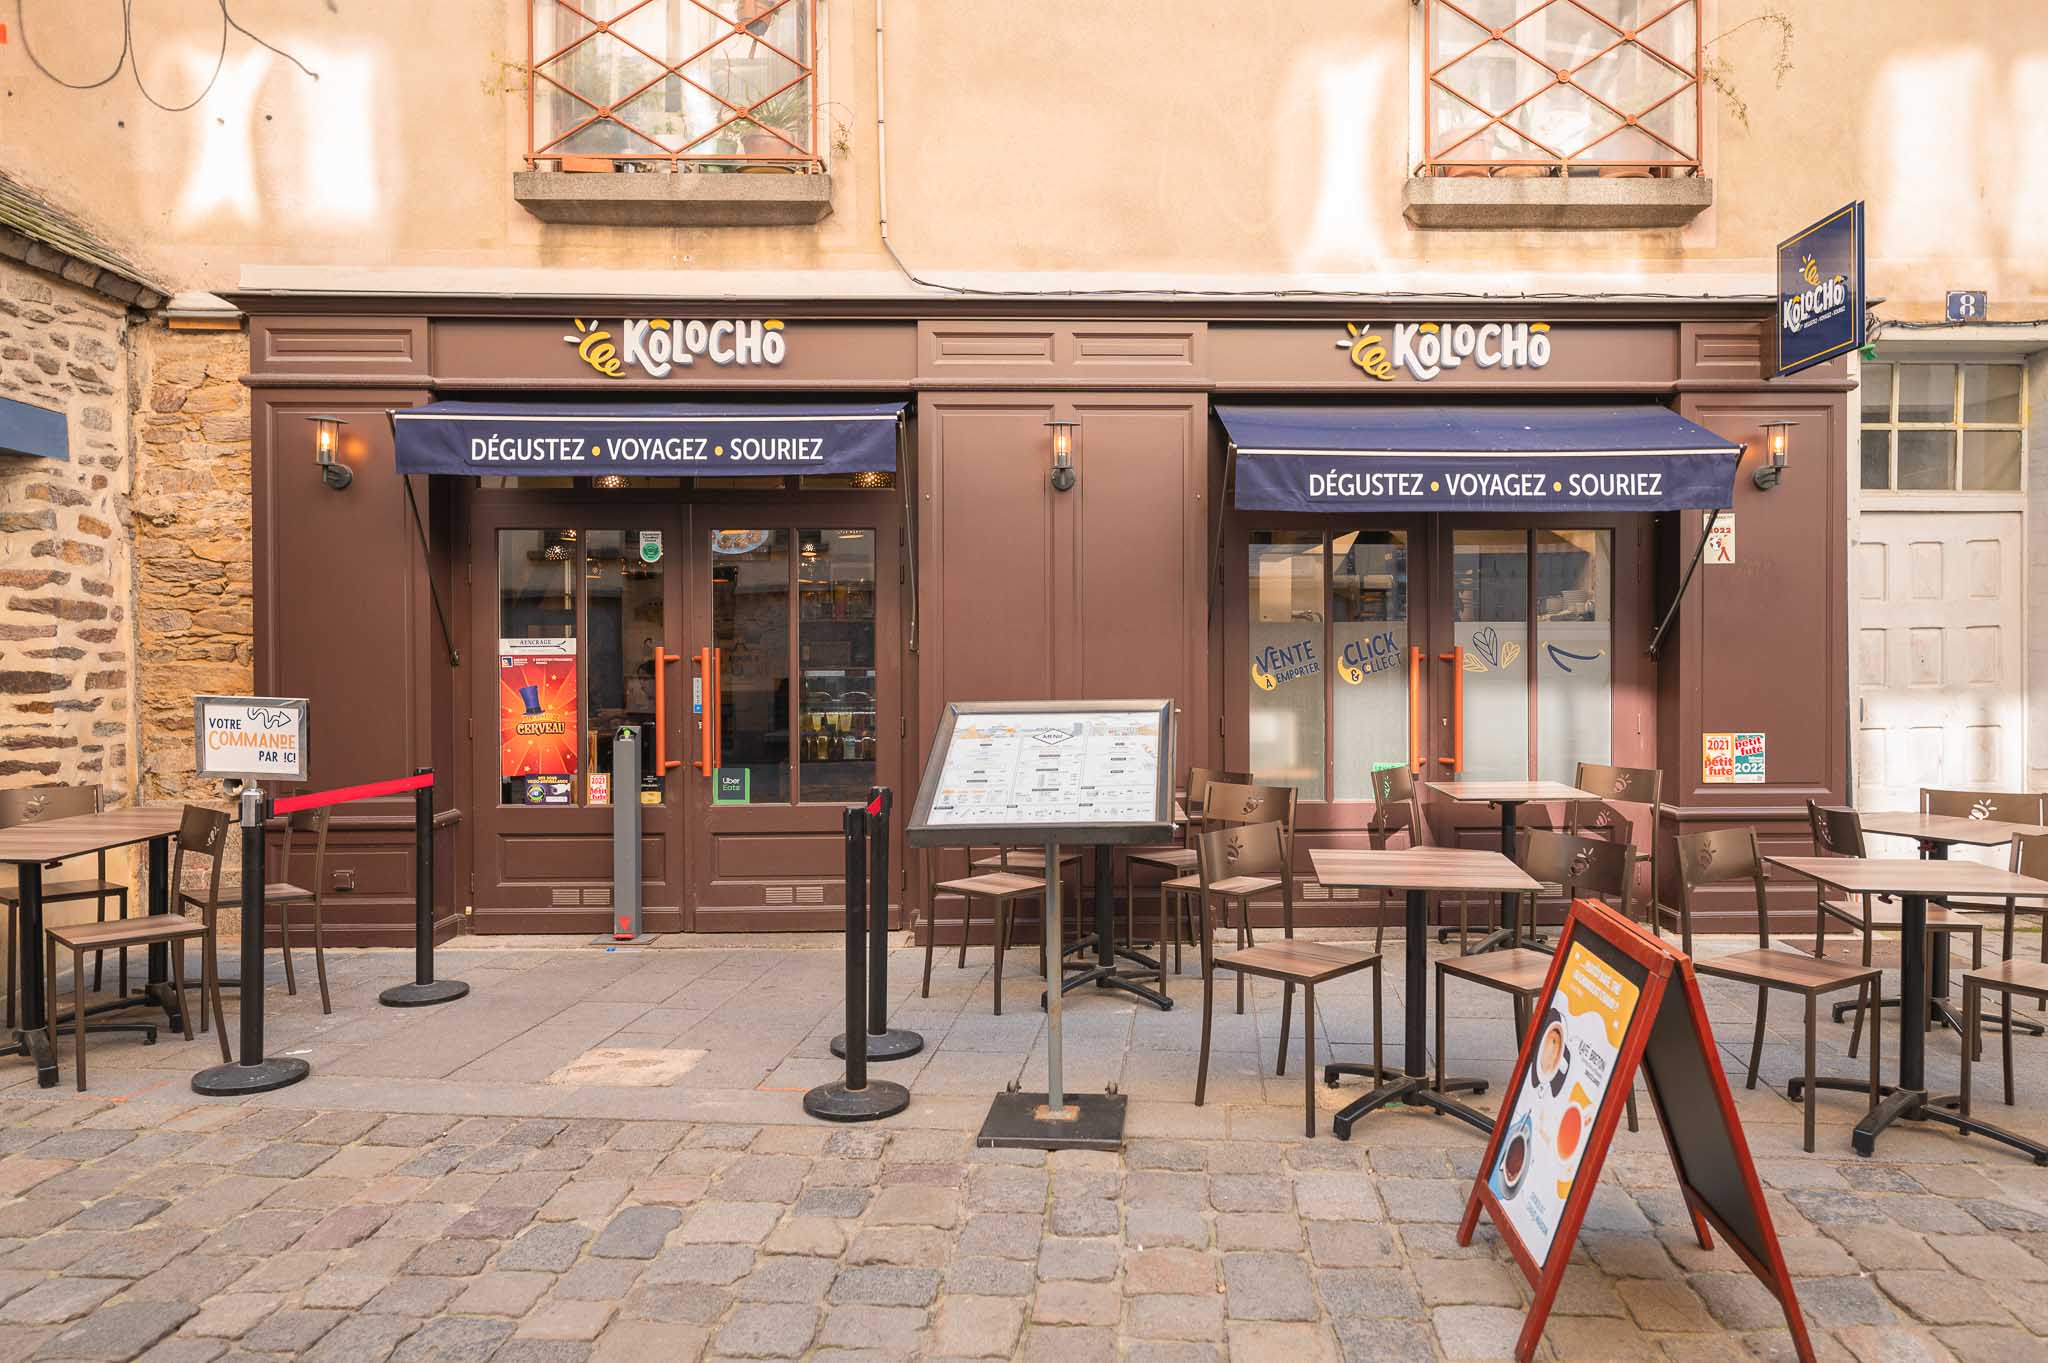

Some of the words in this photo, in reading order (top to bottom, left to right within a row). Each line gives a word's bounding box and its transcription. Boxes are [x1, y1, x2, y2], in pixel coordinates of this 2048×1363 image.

[1959, 294, 1976, 316] 8
[470, 434, 585, 461] DÉGUSTEZ
[605, 438, 708, 461] VOYAGEZ
[729, 437, 824, 461] SOURIEZ
[1308, 469, 1424, 496] DÉGUSTEZ
[1444, 473, 1547, 497] VOYAGEZ
[1568, 473, 1662, 496] SOURIEZ
[1255, 639, 1316, 673] VENTE
[1343, 631, 1399, 666] CLICK
[1275, 662, 1321, 683] EMPORTER
[1351, 669, 1360, 682] &
[208, 717, 242, 730] VOTRE
[516, 721, 566, 736] CERVEAU
[208, 730, 296, 751] COMMANDE
[1707, 739, 1729, 751] 2021
[258, 751, 279, 763] PAR
[1704, 756, 1733, 768] petit
[1735, 762, 1764, 773] 2022
[722, 777, 741, 785] Uber
